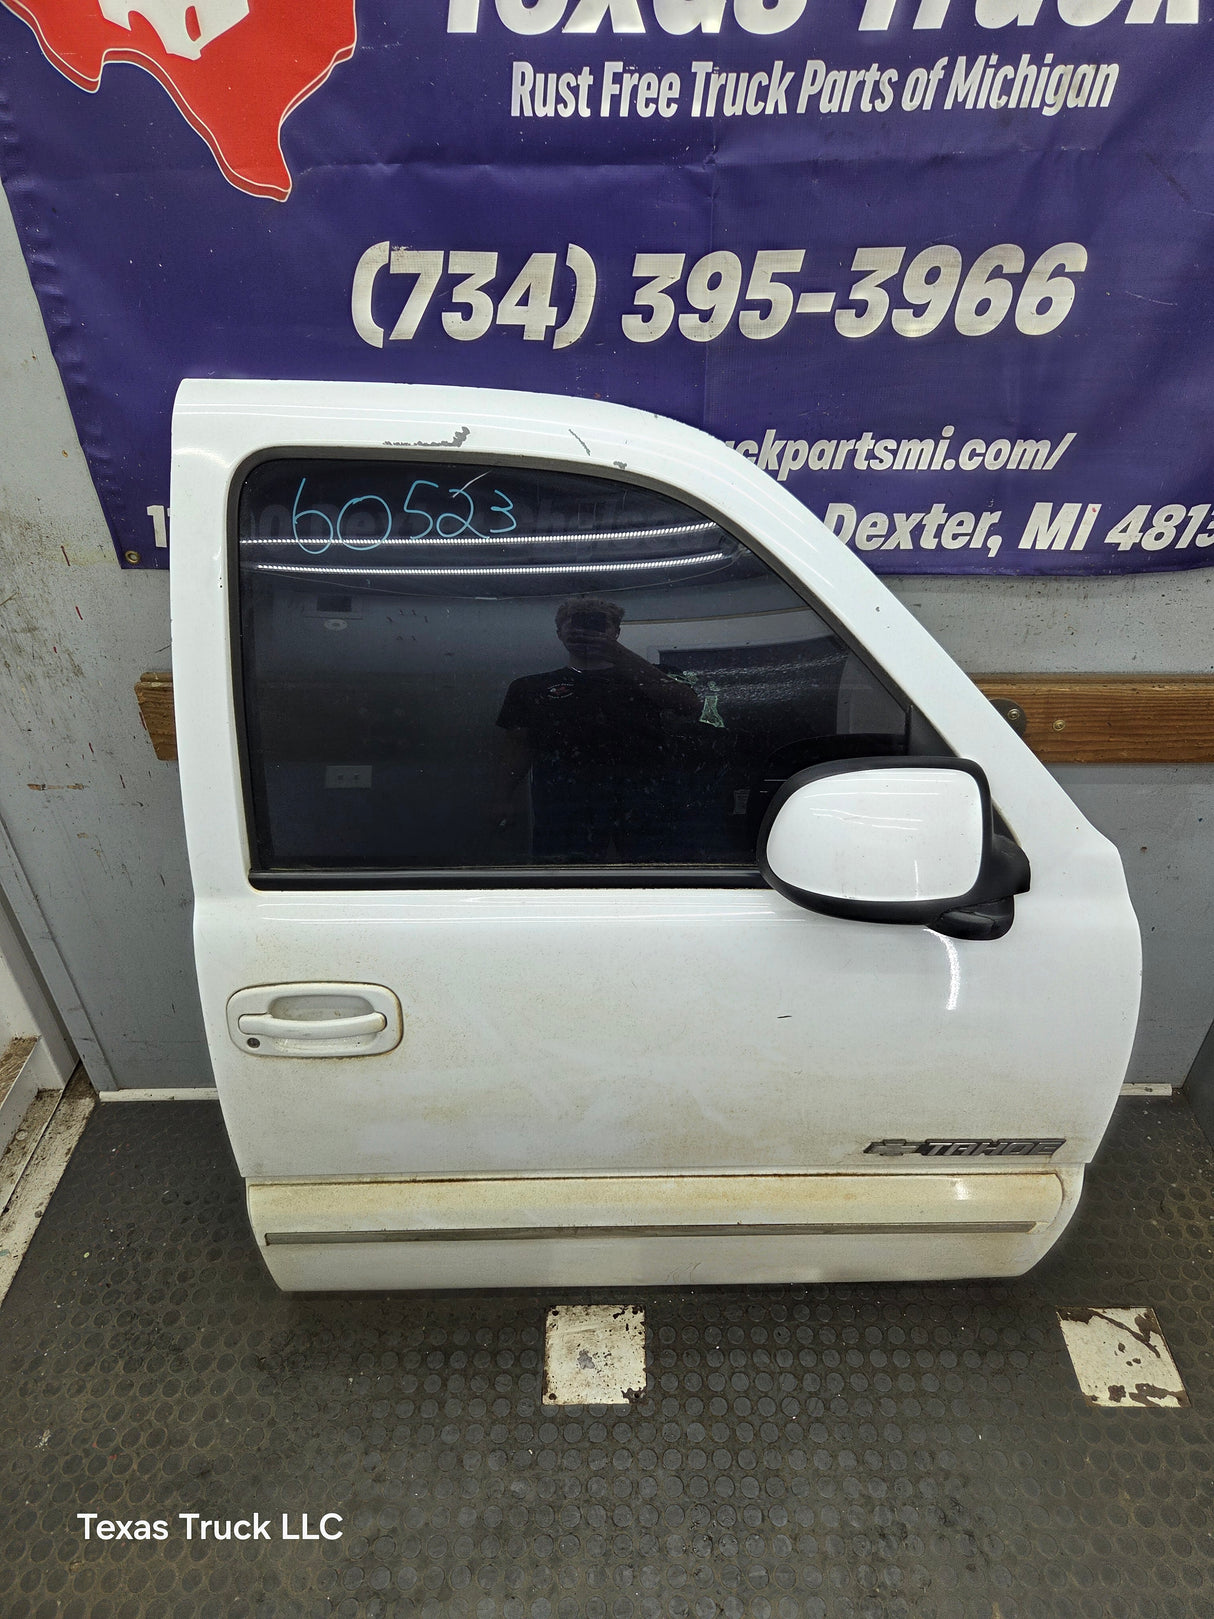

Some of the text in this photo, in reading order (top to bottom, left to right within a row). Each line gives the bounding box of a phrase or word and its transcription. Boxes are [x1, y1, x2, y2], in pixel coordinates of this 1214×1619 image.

[510, 53, 1120, 118] Rust Free Truck Parts of Michigan
[351, 241, 1088, 349] (734) 395-3966
[725, 425, 1078, 482] ckpartsmi.com/
[292, 472, 517, 554] 60523
[822, 502, 1002, 558] Dexter,
[1018, 502, 1102, 551] MI
[926, 1140, 1065, 1156] TAHOE
